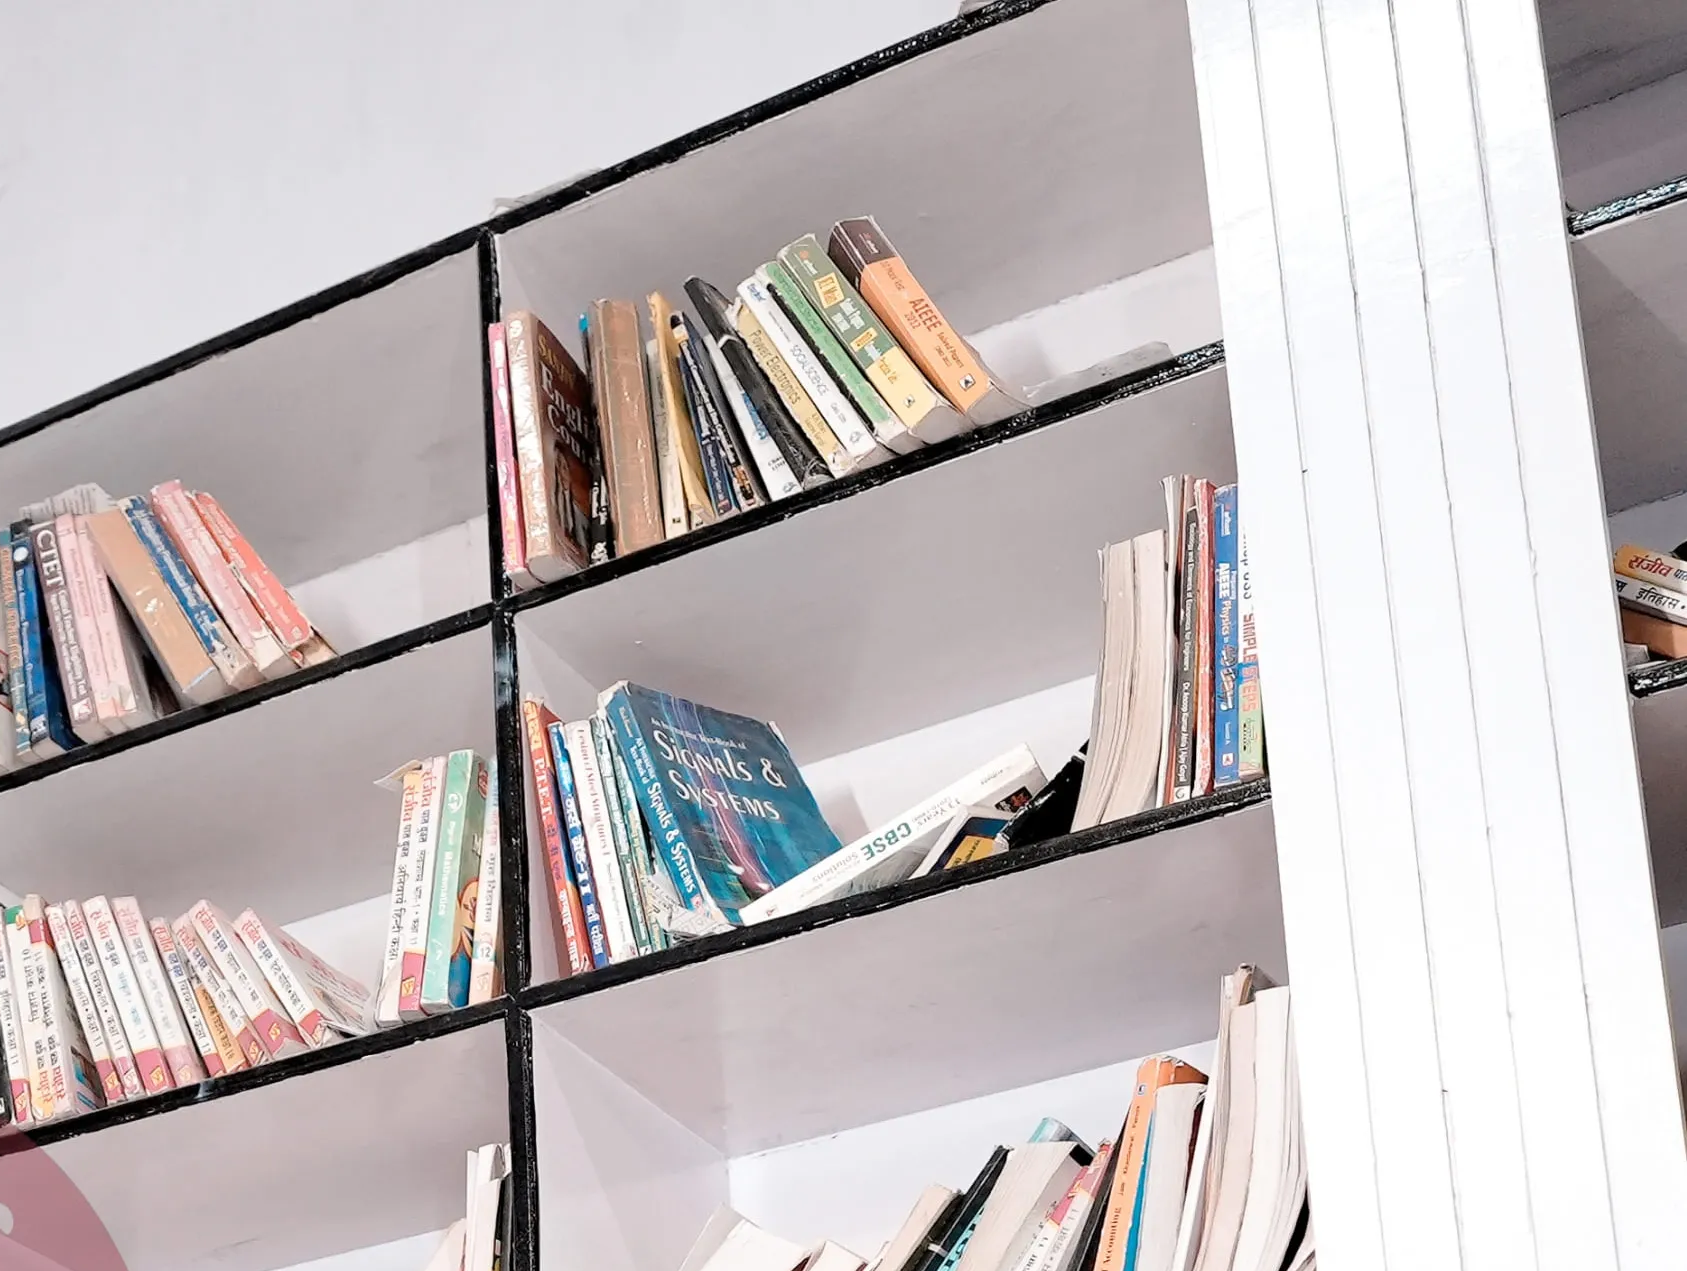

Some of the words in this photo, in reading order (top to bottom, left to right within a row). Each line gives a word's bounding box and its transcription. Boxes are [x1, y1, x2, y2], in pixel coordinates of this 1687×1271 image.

[907, 294, 941, 333] AIEEE
[749, 329, 773, 358] Power
[765, 354, 804, 405] Electronics
[788, 343, 811, 371] SOCIAL
[804, 366, 829, 397] SCIENCE
[35, 528, 65, 589] CTET
[1628, 553, 1673, 578] संजीव
[1217, 563, 1229, 598] AIEEE
[1637, 587, 1678, 610] इतिहास
[1183, 600, 1194, 630] Economics
[1218, 601, 1231, 636] Physics
[1181, 642, 1192, 671] Engineers
[1241, 613, 1257, 664] SIMPLE
[1240, 666, 1259, 711] STEPS
[419, 771, 436, 808] संजीव
[530, 757, 556, 820] P.T.E.T.
[759, 757, 792, 789] &
[401, 785, 419, 822] संजीव
[664, 828, 679, 841] &
[860, 822, 912, 860] CBSE
[392, 864, 407, 904] अनिवार्य
[437, 851, 452, 915] Mathematics
[390, 908, 405, 935] हिन्दी
[1101, 1205, 1123, 1264] Accounting
